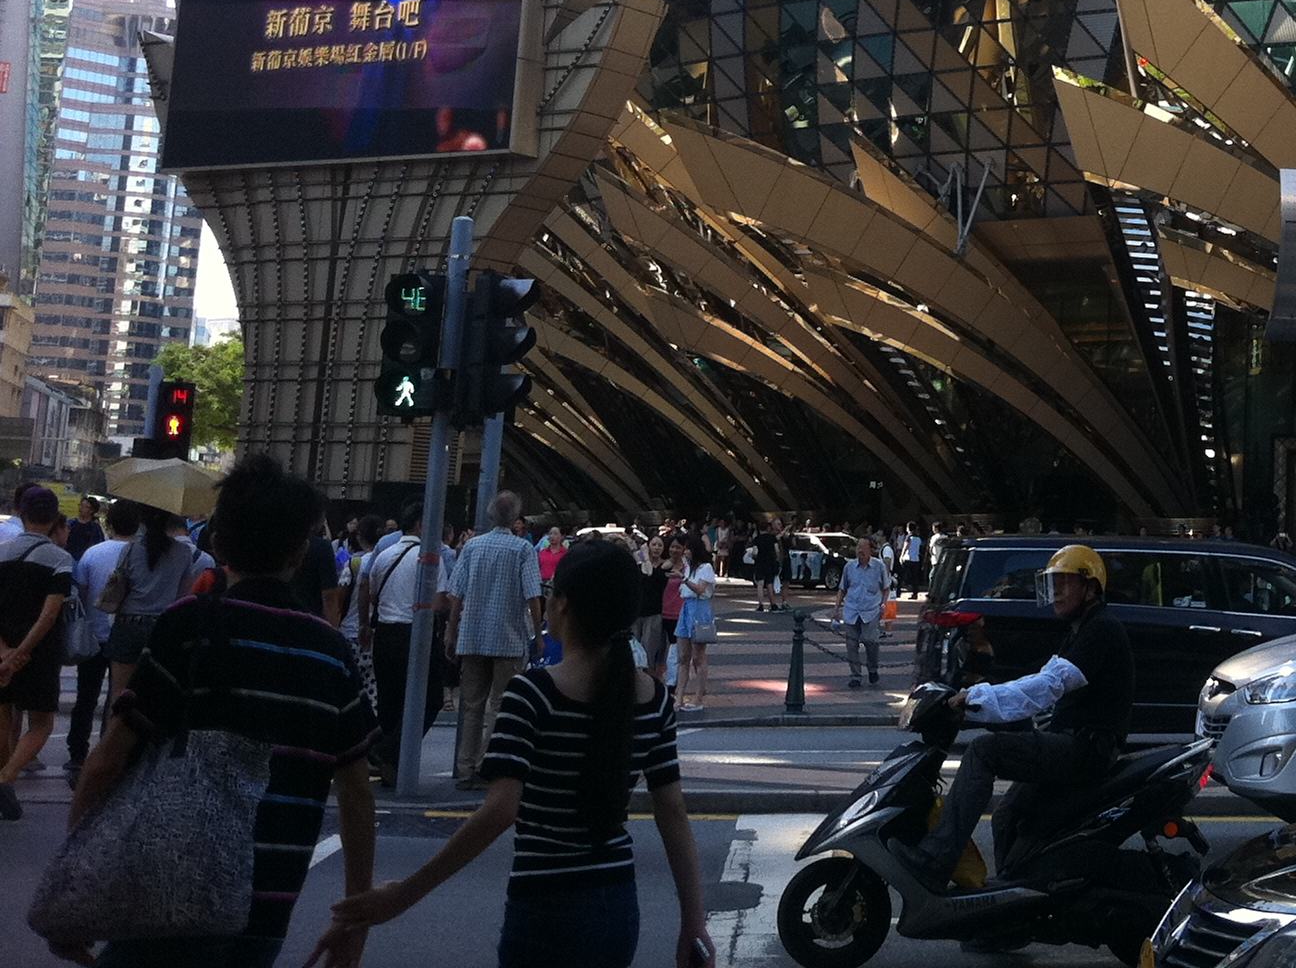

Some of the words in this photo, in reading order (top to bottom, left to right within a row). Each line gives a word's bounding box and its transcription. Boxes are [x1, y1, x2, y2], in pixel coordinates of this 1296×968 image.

[265, 4, 335, 39] 新葡京
[172, 388, 189, 405] 14
